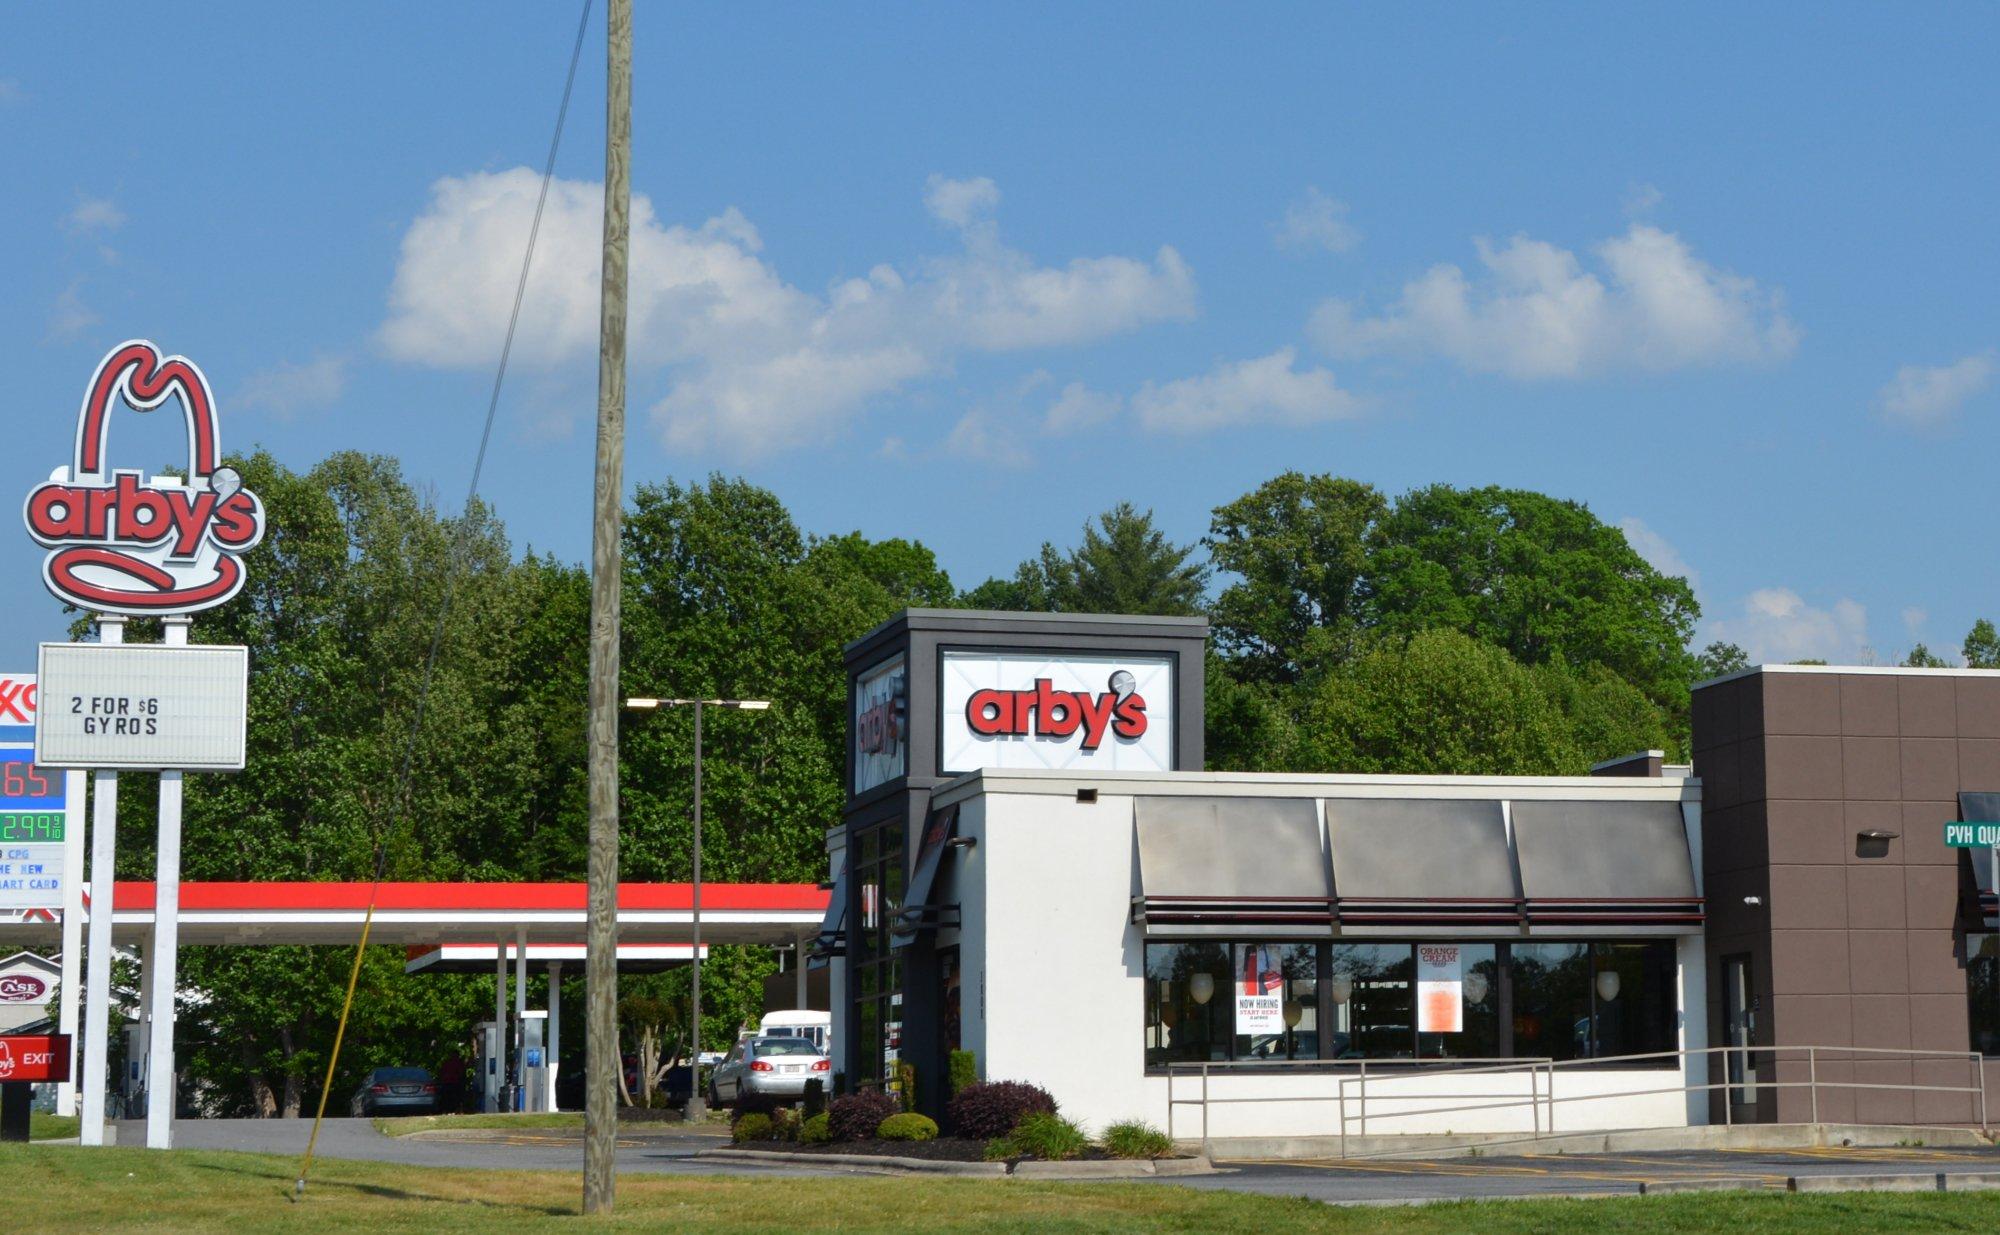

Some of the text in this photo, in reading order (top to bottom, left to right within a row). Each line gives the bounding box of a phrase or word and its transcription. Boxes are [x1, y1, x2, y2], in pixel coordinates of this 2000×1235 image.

[27, 467, 259, 557] arby's
[72, 697, 158, 715] 2 FOR $6
[965, 670, 1148, 751] arby's
[84, 717, 157, 735] GYROS
[1947, 825, 1973, 844] PVH
[21, 864, 43, 874] NEW
[0, 880, 58, 889] ART CARD
[1421, 947, 1459, 955] ORANGE
[1239, 999, 1279, 1009] NOW HIRING
[23, 1052, 54, 1065] EXIT
